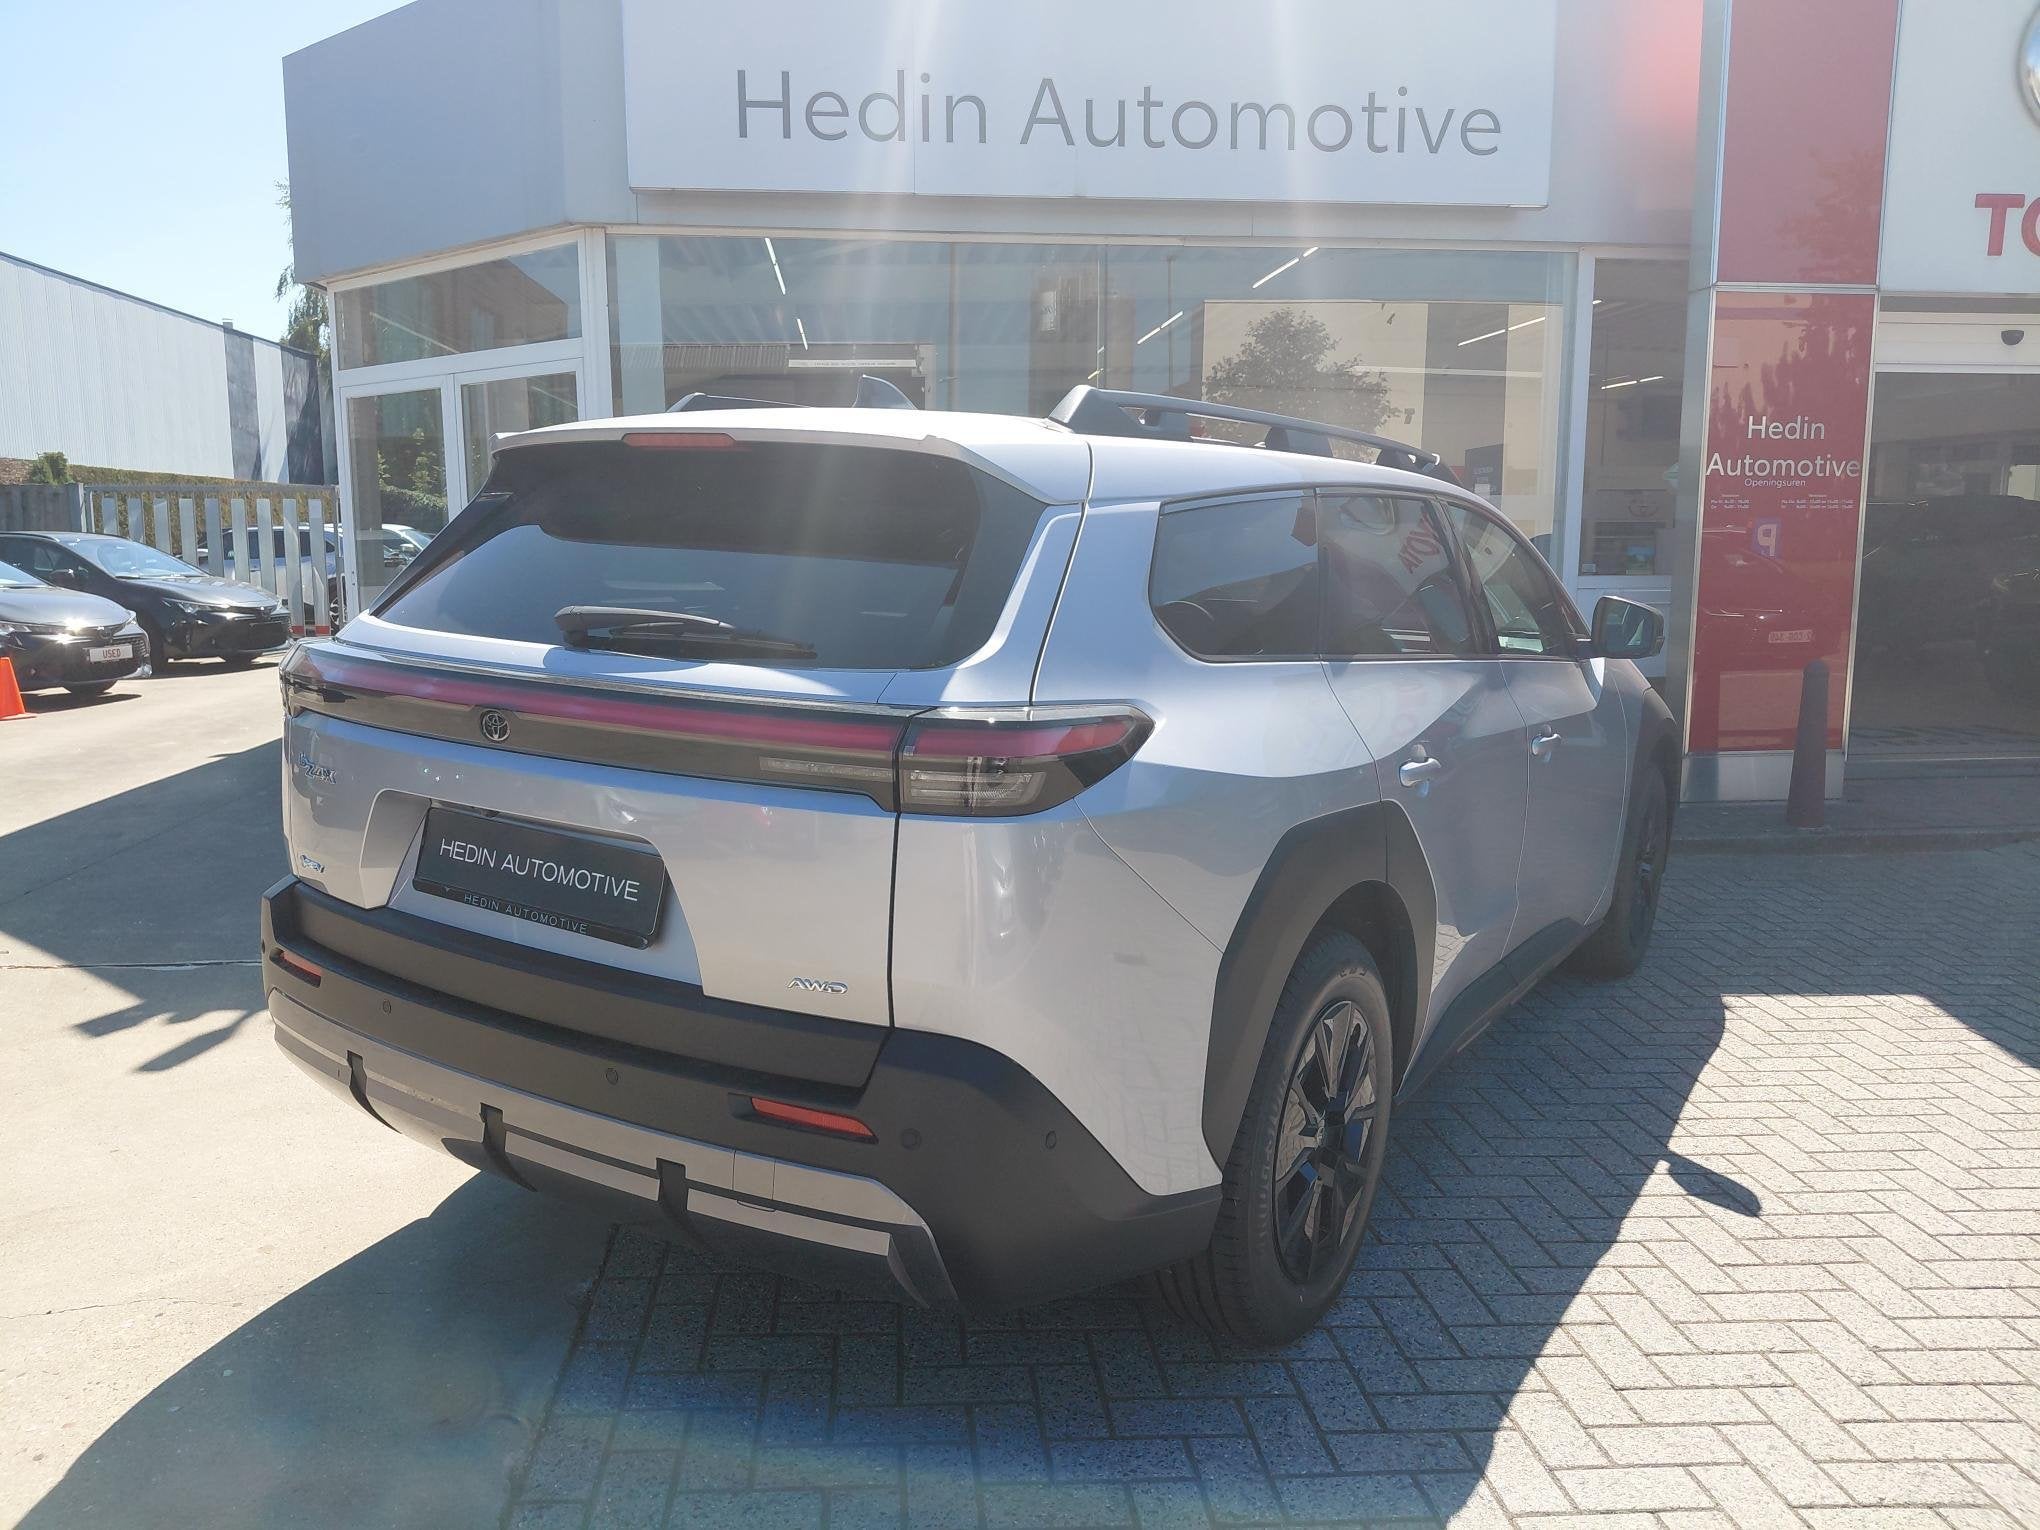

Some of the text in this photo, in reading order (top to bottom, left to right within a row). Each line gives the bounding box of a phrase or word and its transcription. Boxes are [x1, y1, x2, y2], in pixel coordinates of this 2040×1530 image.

[736, 69, 1502, 156] Hedin Automotive
[1747, 415, 1825, 440] Hedin
[1705, 452, 1860, 478] Automotive
[1744, 478, 1806, 489] Openingsuren
[102, 648, 121, 659] USED
[439, 838, 641, 902] HEDIN AUTOMOTIVE
[464, 893, 588, 935] HEDIN AUTOMOTIVE
[787, 976, 848, 994] AWD
